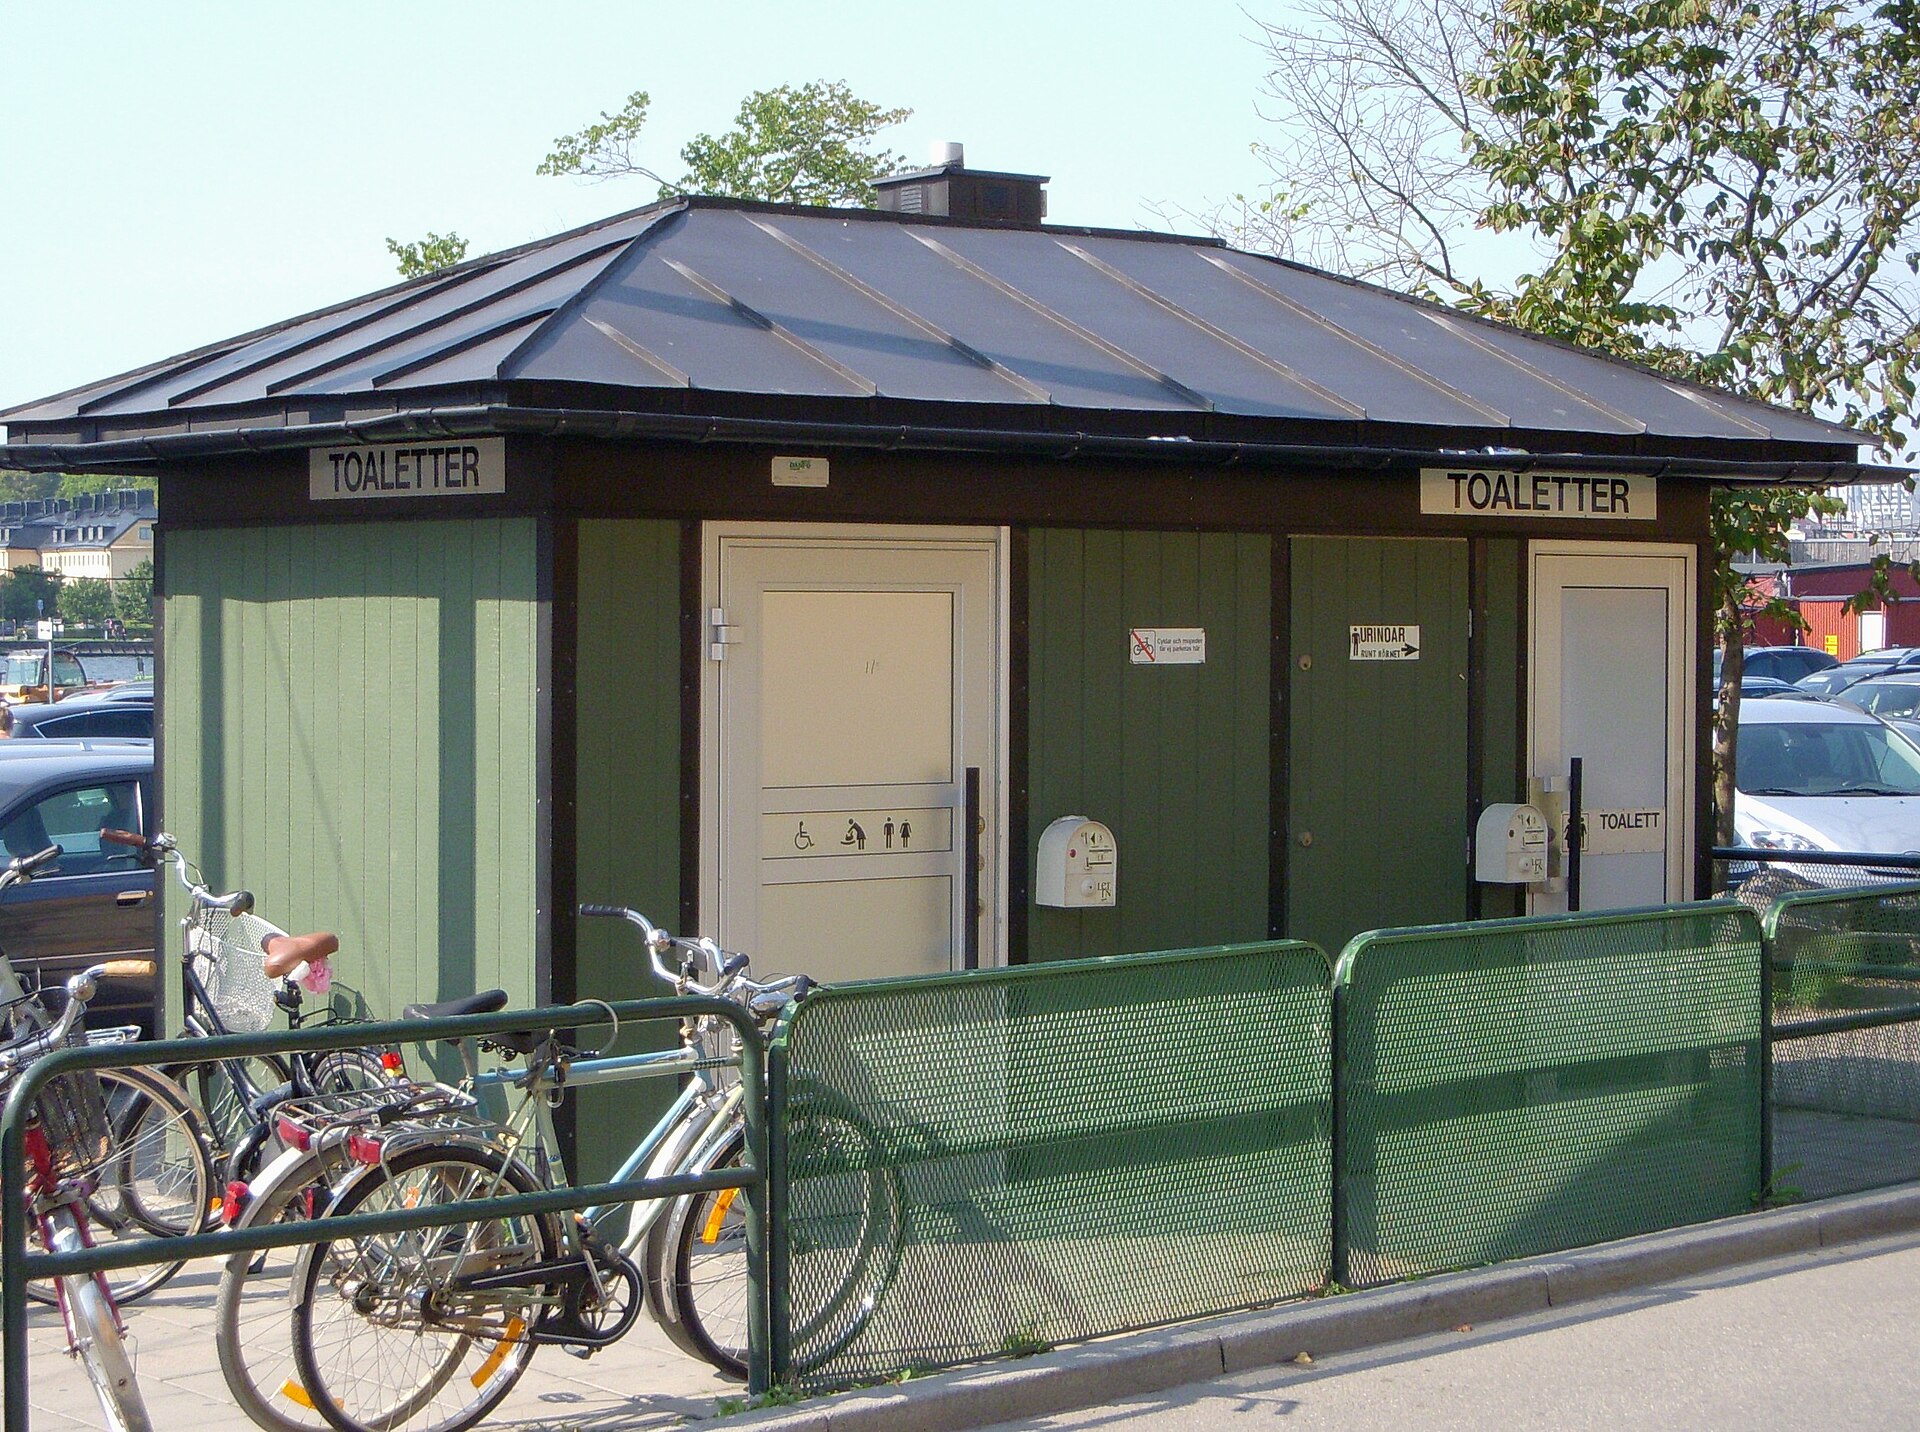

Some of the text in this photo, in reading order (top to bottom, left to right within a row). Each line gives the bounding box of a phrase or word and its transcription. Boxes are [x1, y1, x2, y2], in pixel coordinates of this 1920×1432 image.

[329, 445, 480, 492] TOALETTER
[1447, 472, 1630, 514] TOALETTER
[1360, 627, 1405, 643] URINOAR
[1361, 649, 1377, 658] RUNT
[1600, 812, 1660, 830] TOALETT
